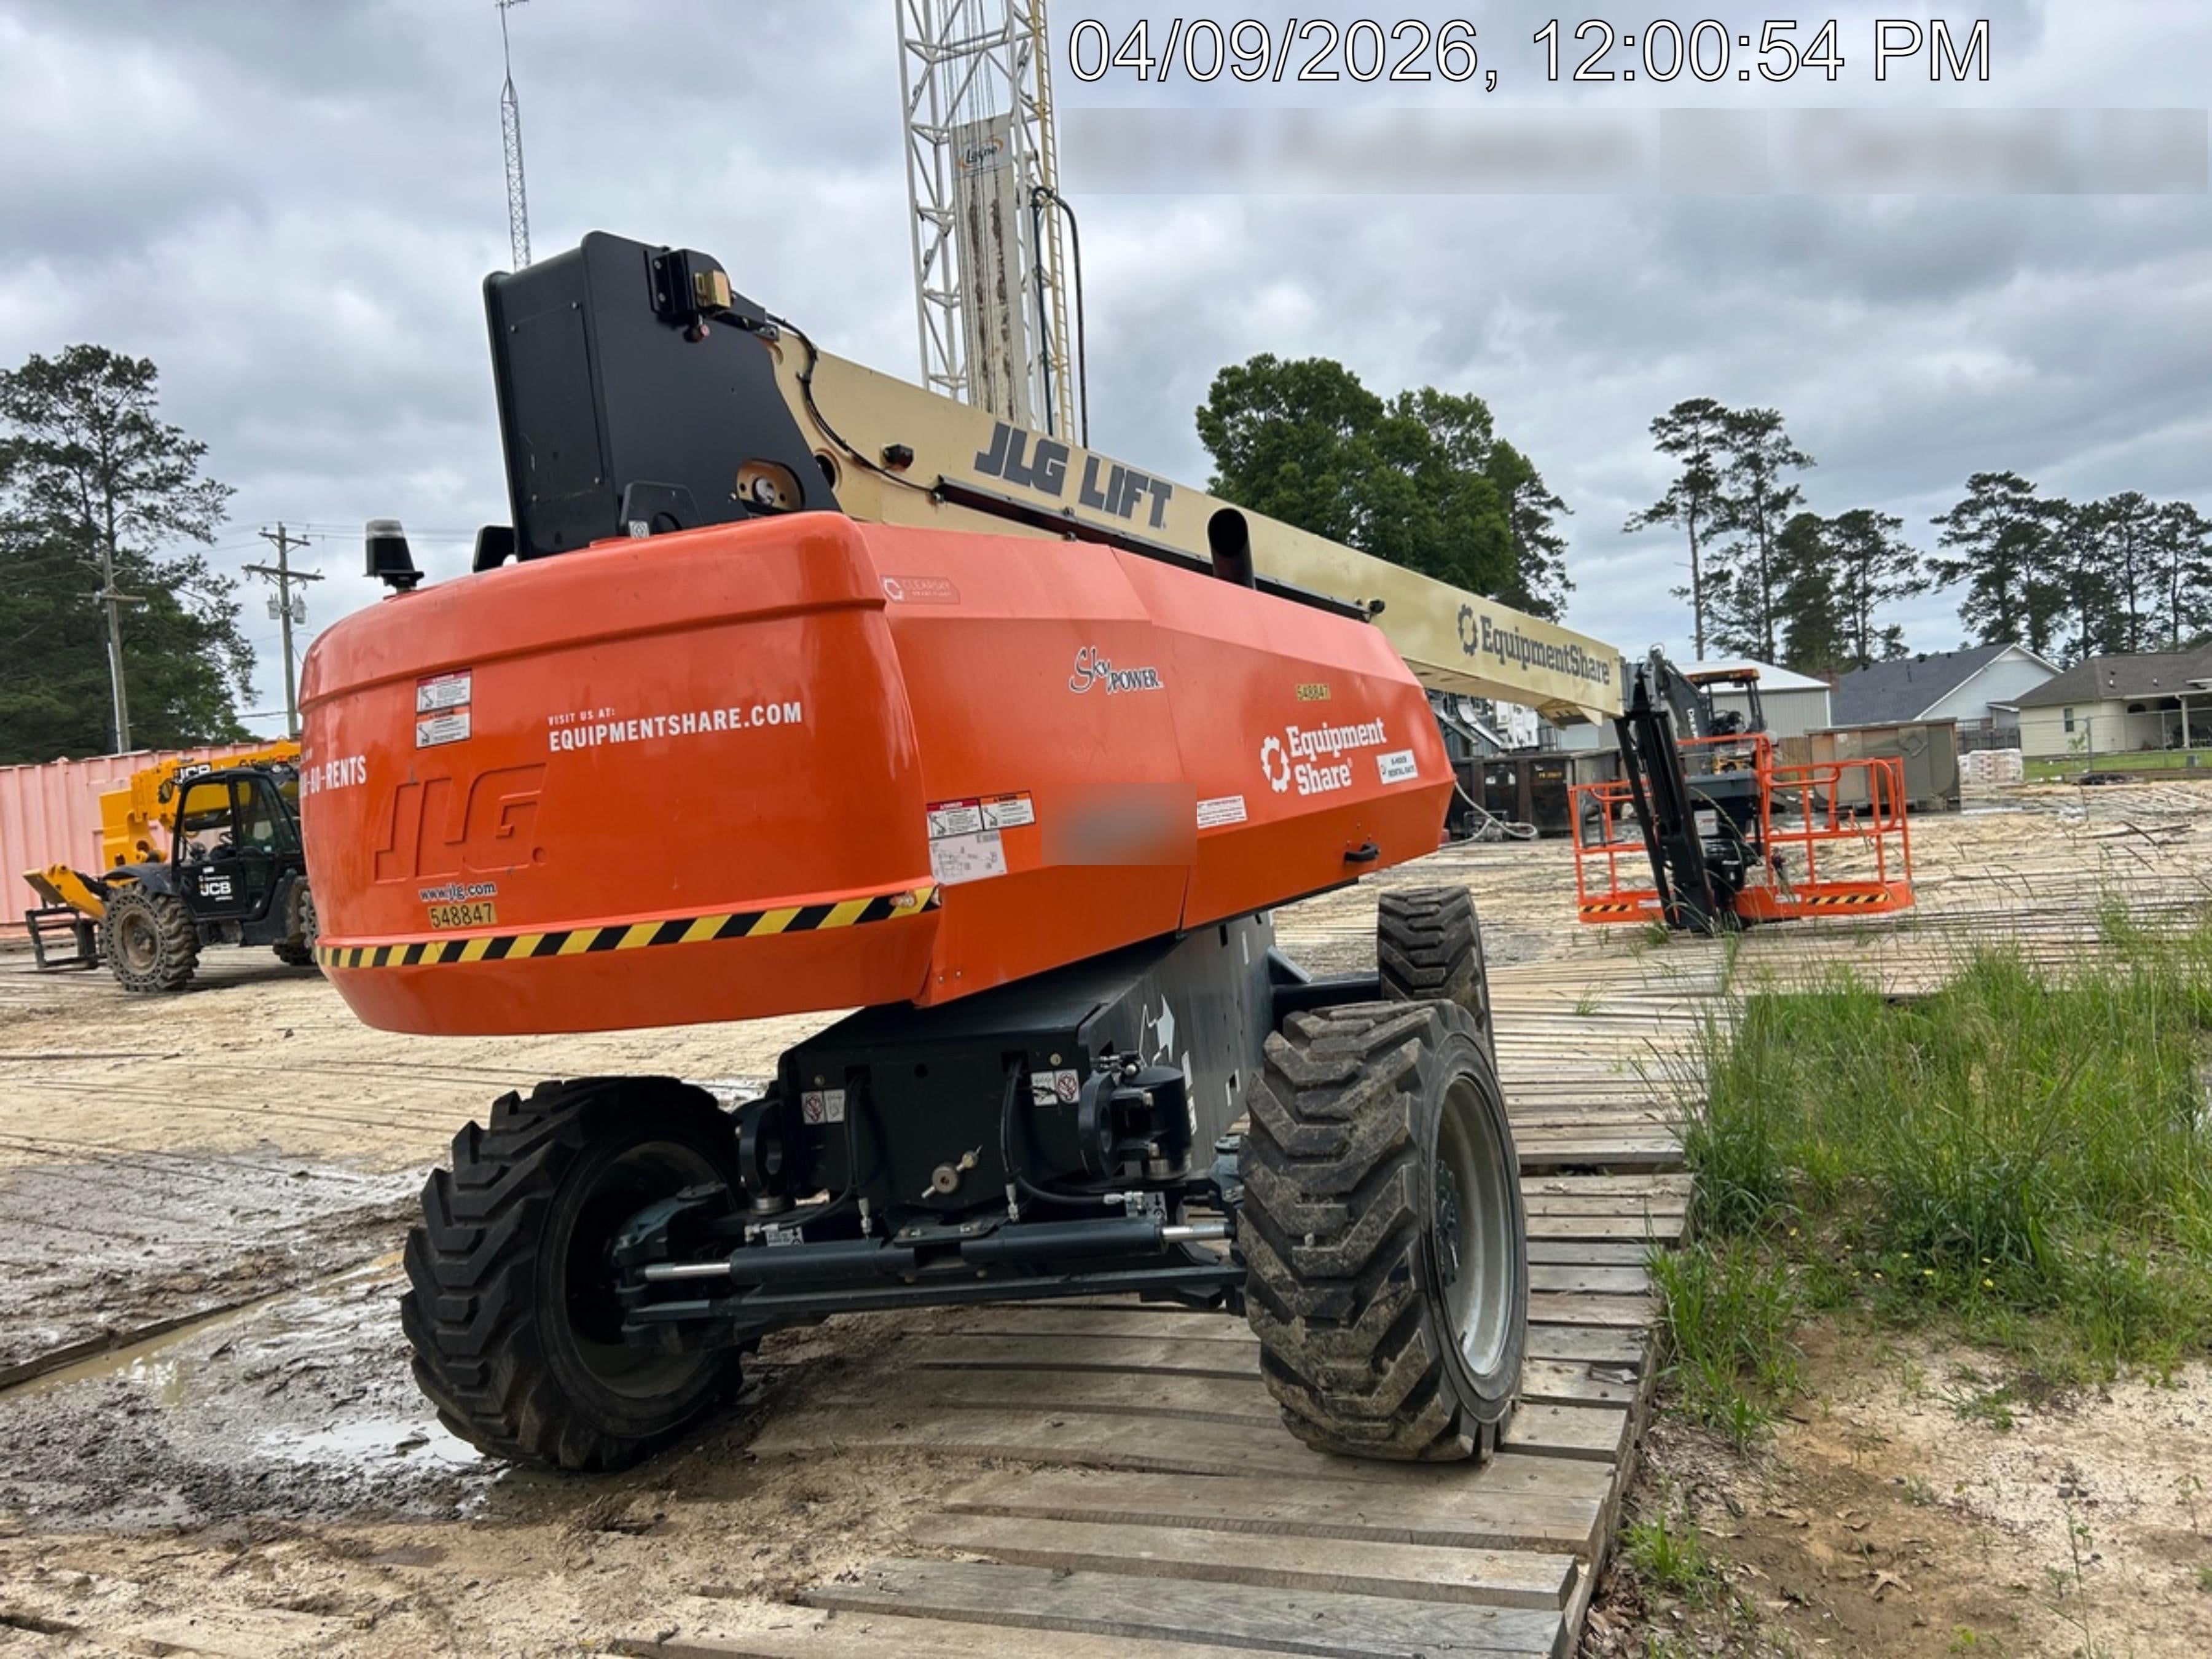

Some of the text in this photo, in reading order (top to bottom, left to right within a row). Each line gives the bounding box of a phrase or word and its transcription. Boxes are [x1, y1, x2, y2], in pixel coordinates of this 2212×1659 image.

[975, 422, 1173, 529] JLG LIFT
[1480, 615, 1610, 686] EquipmentShare
[547, 707, 615, 726] VISIT US AT:
[549, 702, 803, 753] EQUIPMENTSHARE.COM
[1285, 717, 1387, 762] Equipment
[1294, 762, 1352, 796] Share
[374, 763, 547, 884] JLG
[200, 881, 232, 896] JCB
[420, 882, 497, 901] www.jlg.com
[430, 903, 492, 928] 548847
